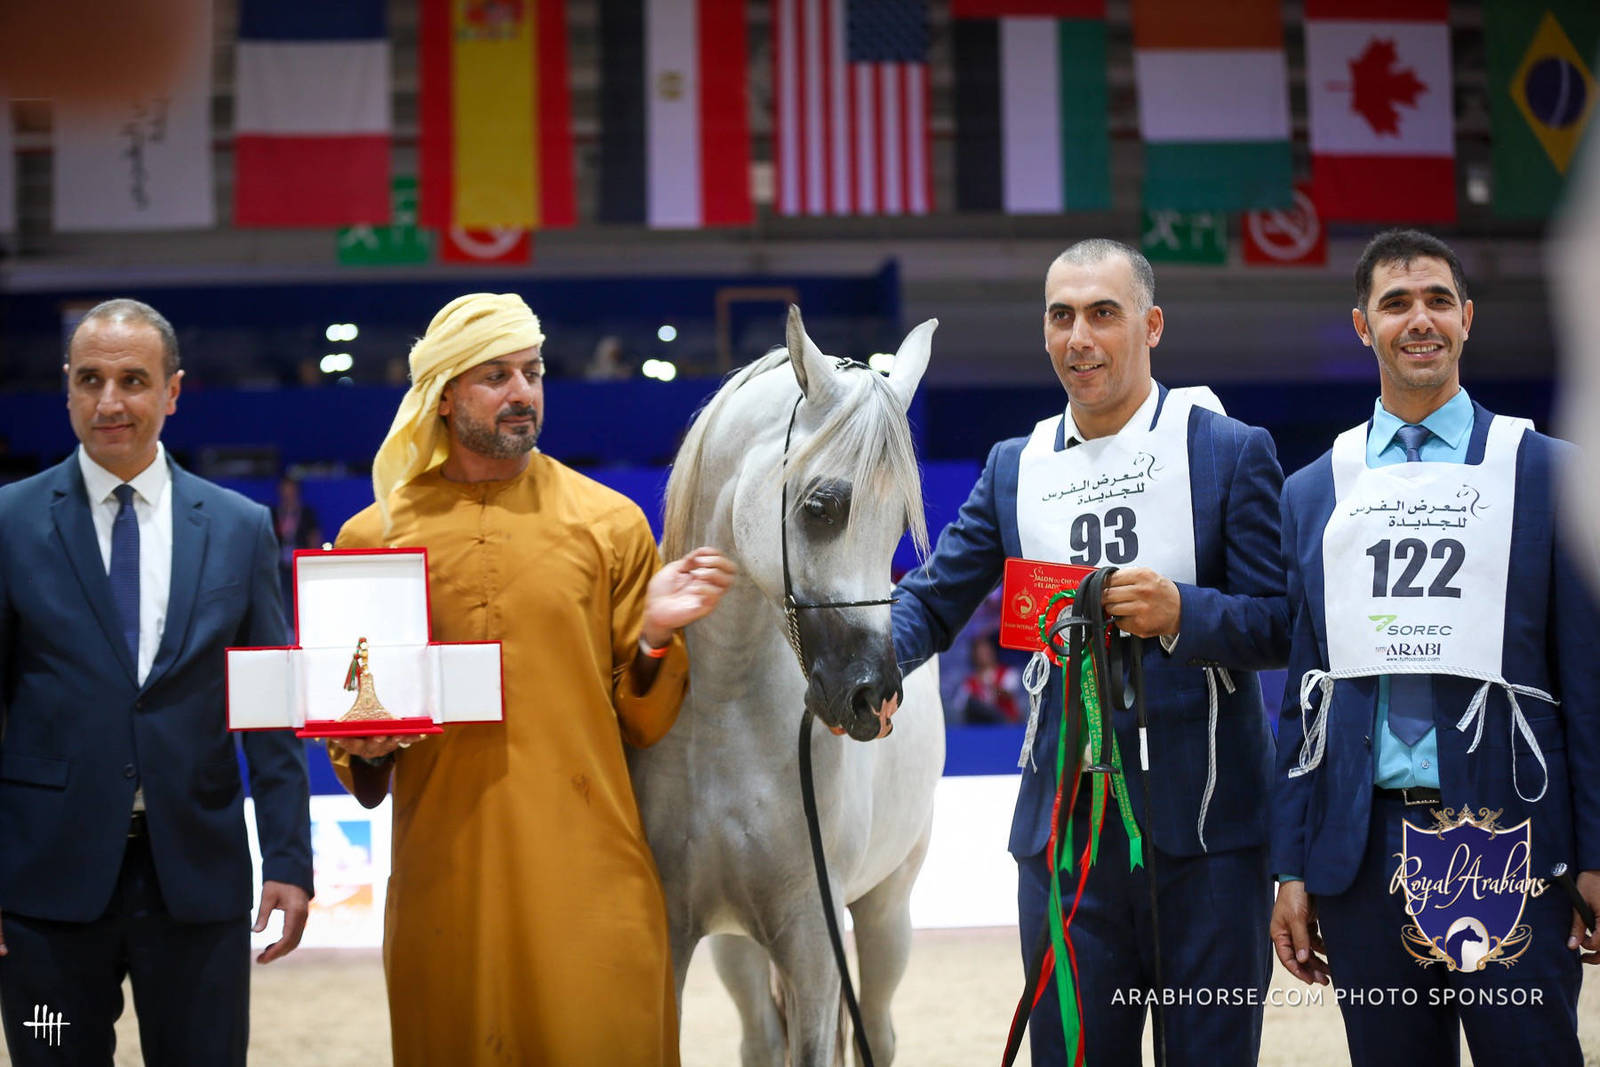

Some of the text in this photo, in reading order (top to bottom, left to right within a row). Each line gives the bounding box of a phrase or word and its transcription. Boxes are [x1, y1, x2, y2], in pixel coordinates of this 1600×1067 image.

[1092, 471, 1144, 490] معرض
[1077, 482, 1145, 505] للجديدة
[1407, 499, 1467, 515] معرض
[1388, 516, 1468, 531] للجديدة
[1069, 506, 1139, 567] 93
[1365, 537, 1466, 599] 122
[1387, 625, 1453, 636] SOREC
[1386, 642, 1441, 656] ARABI
